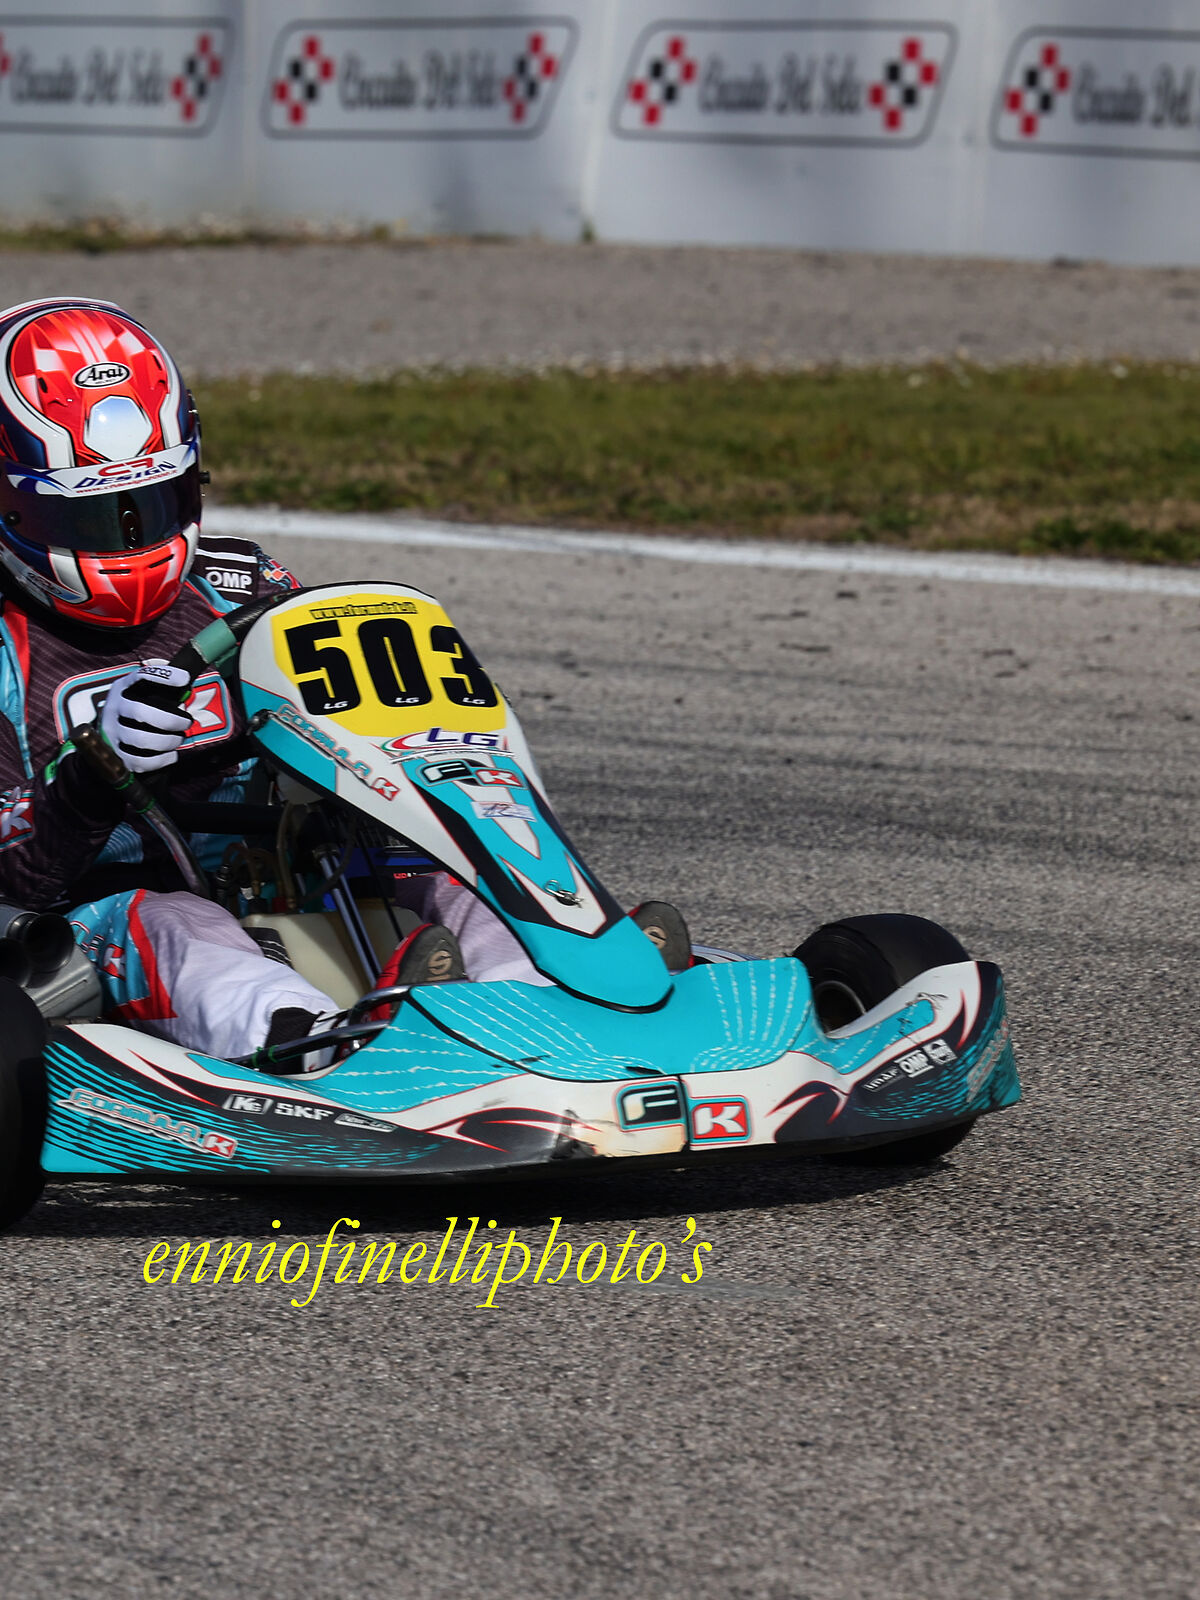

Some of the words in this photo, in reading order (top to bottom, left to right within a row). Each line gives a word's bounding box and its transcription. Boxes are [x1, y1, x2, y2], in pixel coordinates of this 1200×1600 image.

[80, 366, 123, 384] Arai
[73, 461, 177, 489] DESIGN
[206, 571, 252, 589] OMP
[285, 617, 498, 716] 503
[427, 728, 499, 747] LG
[899, 1053, 929, 1075] OMP
[274, 1102, 335, 1121] SKF
